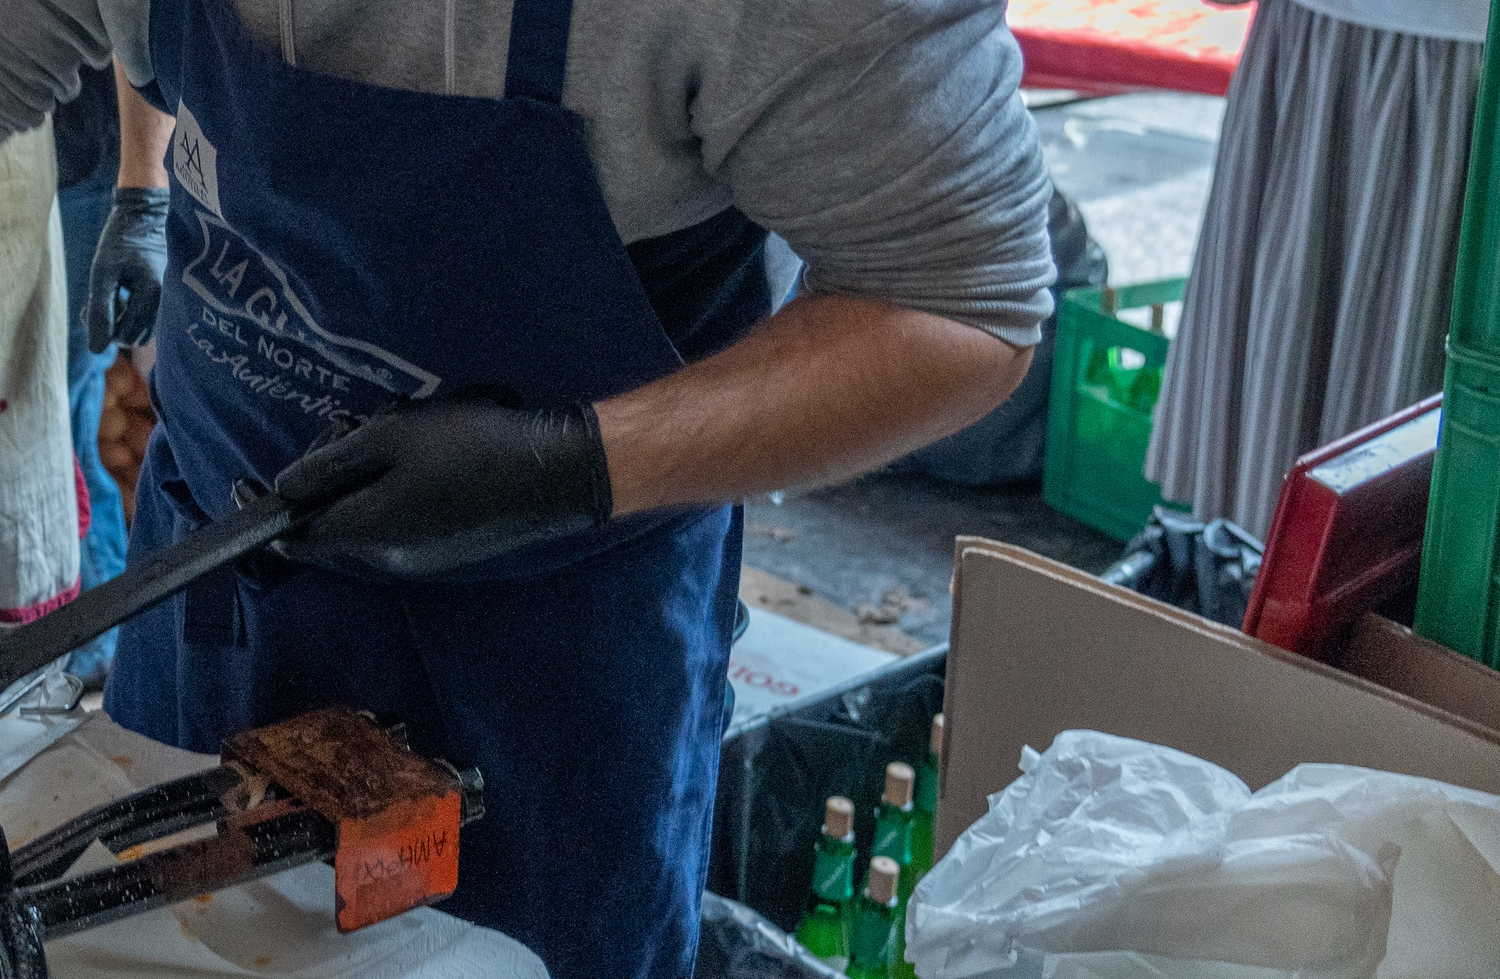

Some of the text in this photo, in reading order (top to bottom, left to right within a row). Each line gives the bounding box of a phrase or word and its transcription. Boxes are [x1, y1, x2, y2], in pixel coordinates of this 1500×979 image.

[209, 239, 250, 299] LA
[202, 305, 352, 394] DEL NORTE
